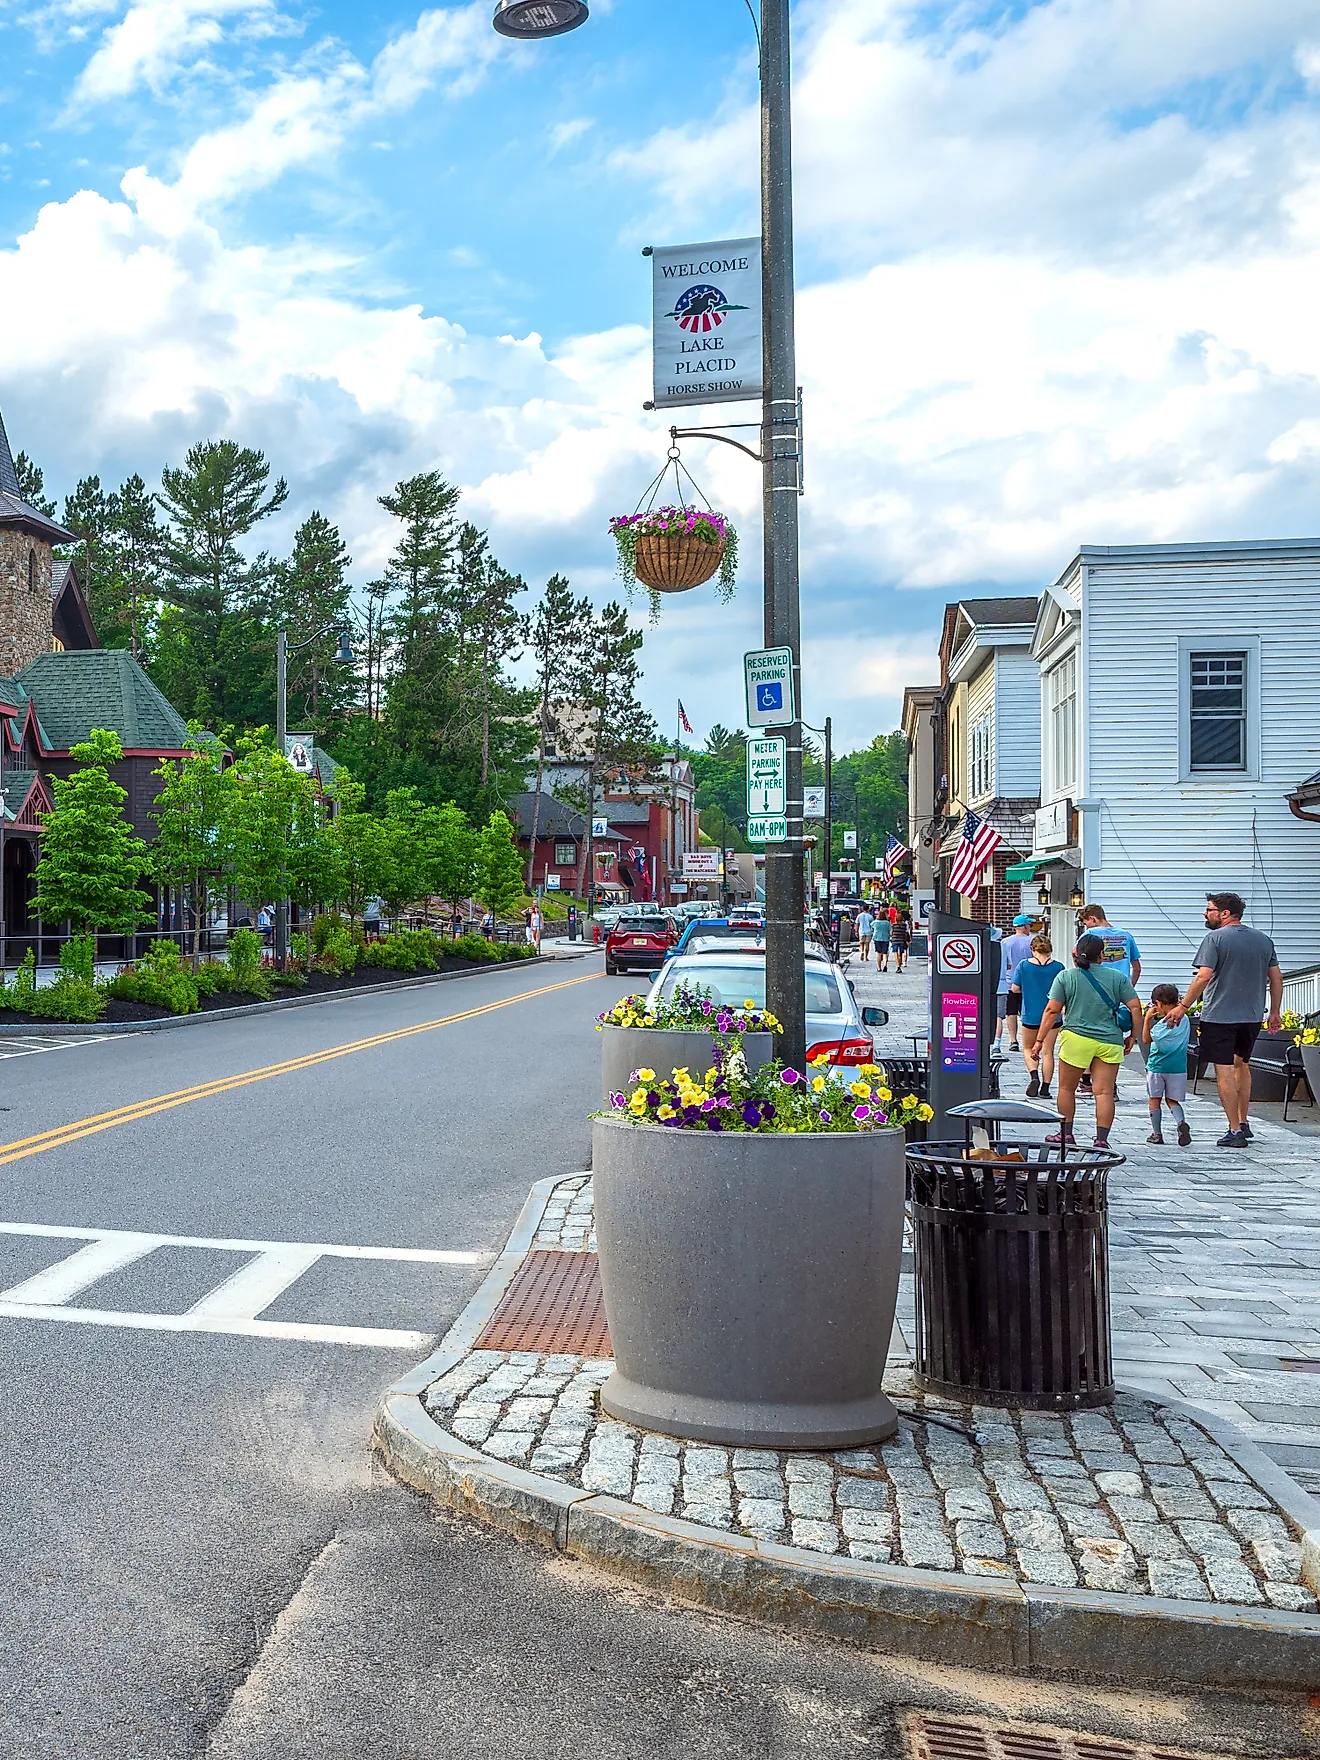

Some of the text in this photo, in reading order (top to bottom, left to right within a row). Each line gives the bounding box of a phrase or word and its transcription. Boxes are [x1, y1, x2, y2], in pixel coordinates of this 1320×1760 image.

[661, 257, 749, 278] WELCOME
[680, 337, 725, 353] LAKE
[675, 358, 737, 375] PLACID
[667, 379, 743, 395] HORSE SHOW
[747, 654, 788, 669] RESERVED
[750, 668, 786, 681] PARKING
[754, 742, 778, 753] METER
[751, 757, 781, 769] PARKING
[749, 778, 783, 790] PAY HERE
[749, 821, 785, 837] 8AM-8PM
